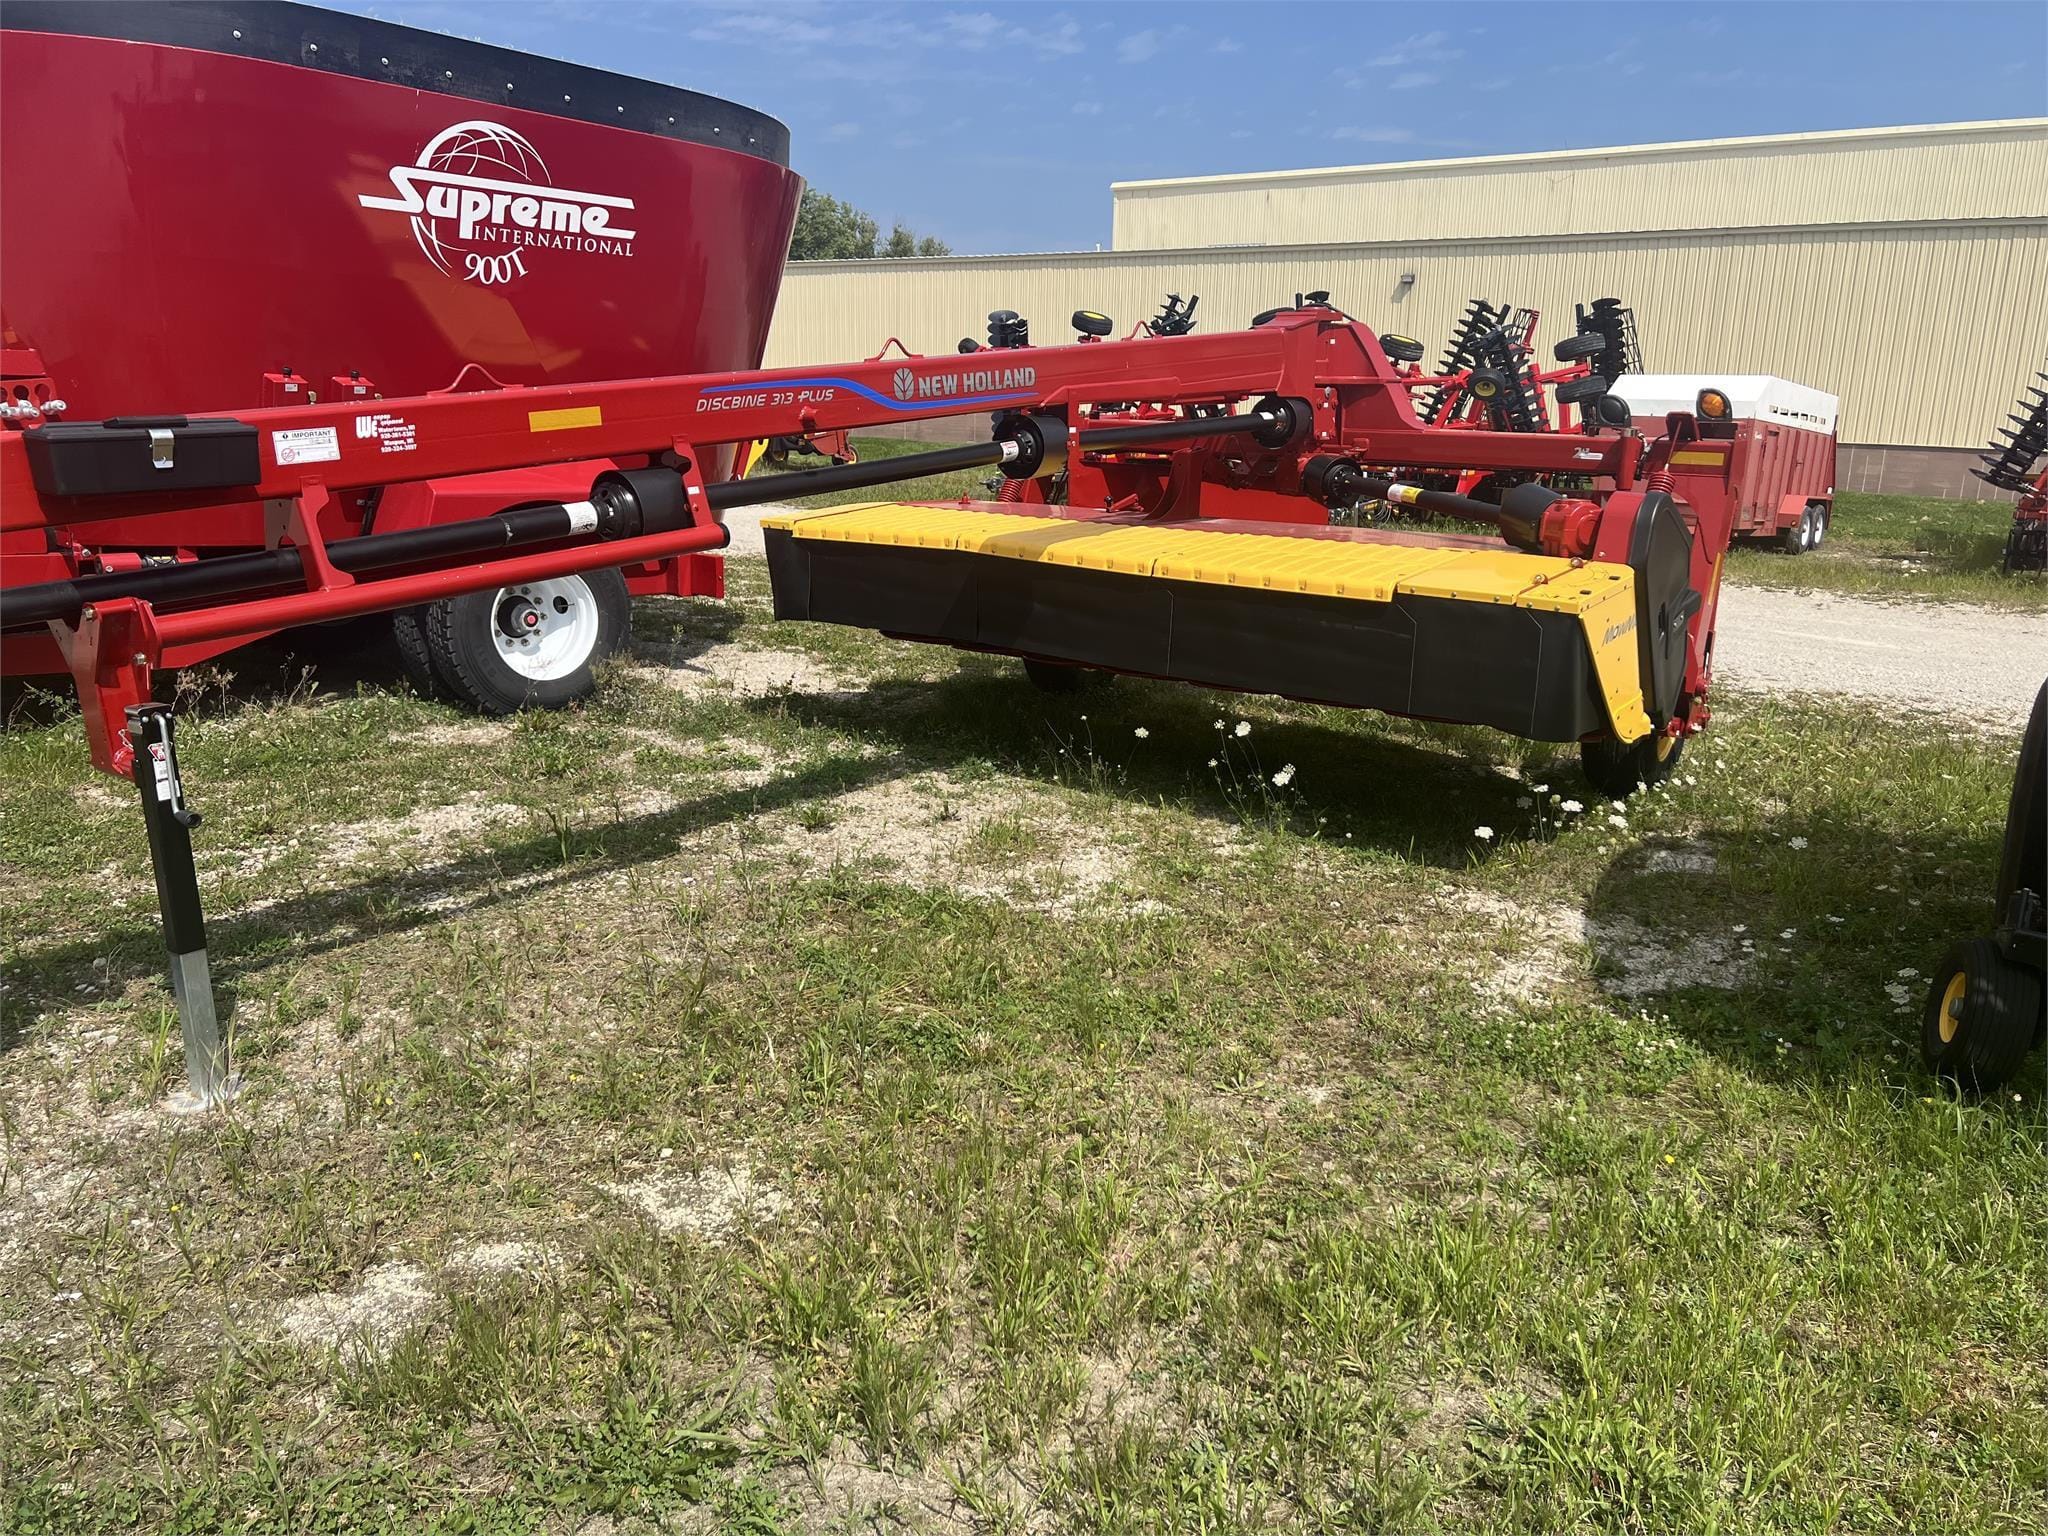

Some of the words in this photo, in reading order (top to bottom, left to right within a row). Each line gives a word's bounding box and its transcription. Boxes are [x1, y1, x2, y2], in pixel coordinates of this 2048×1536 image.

[358, 165, 636, 239] Supreme
[474, 225, 634, 256] INTERNATIONAL
[463, 246, 529, 284] 900T
[918, 374, 958, 398] NEW
[963, 366, 1037, 392] HOLLAND
[695, 393, 767, 412] DISCBINE
[770, 392, 794, 406] 313
[291, 430, 331, 438] IMPORTANT
